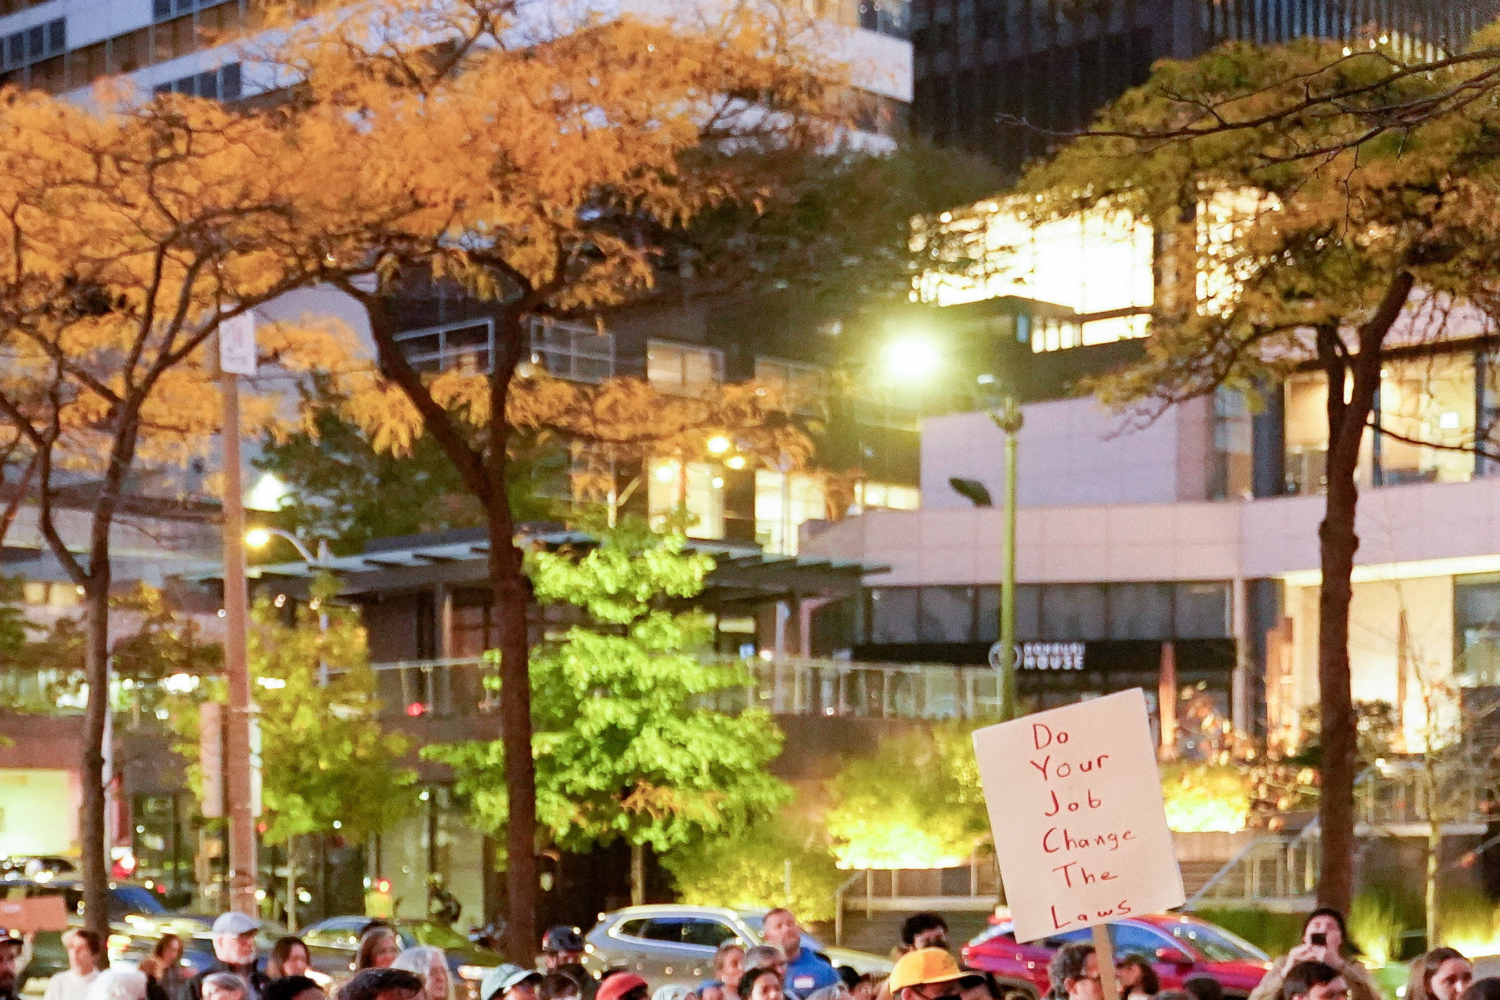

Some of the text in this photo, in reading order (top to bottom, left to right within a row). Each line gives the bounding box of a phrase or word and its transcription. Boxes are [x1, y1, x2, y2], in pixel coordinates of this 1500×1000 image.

[1023, 656, 1085, 671] HOUSE
[1032, 723, 1069, 750] Do
[1029, 754, 1109, 781] Your
[1044, 789, 1102, 817] Job
[1042, 827, 1137, 853] Change
[1051, 861, 1119, 889] The
[1050, 899, 1132, 930] Laws
